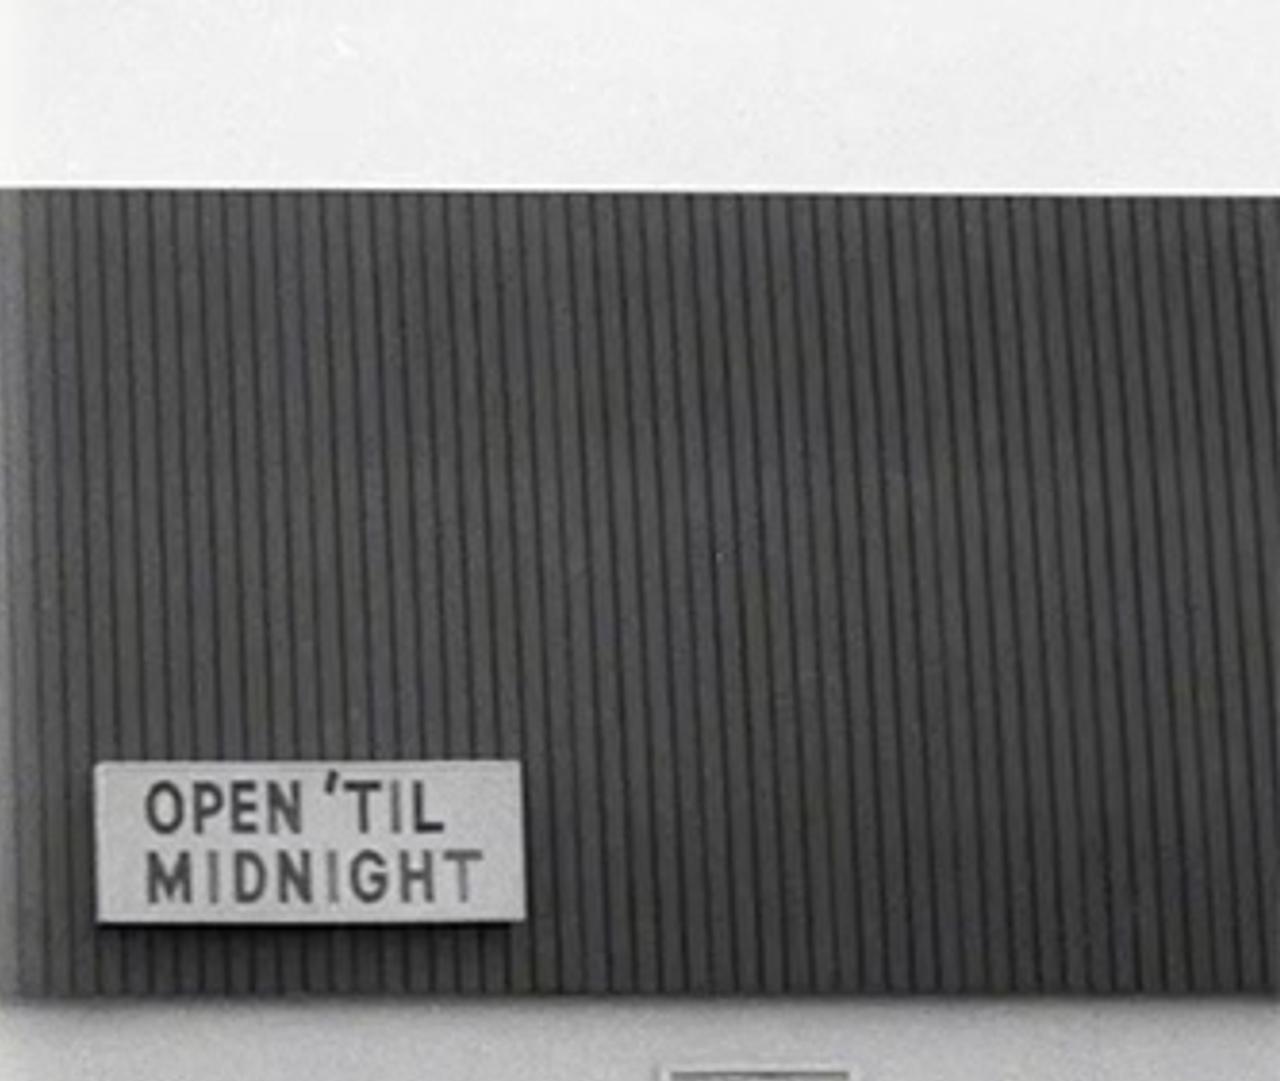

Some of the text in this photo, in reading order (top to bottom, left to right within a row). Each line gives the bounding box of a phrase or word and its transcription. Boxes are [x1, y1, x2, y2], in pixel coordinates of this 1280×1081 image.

[144, 769, 445, 835] OPEN 'TIL
[146, 849, 484, 904] MIDNIGHT
